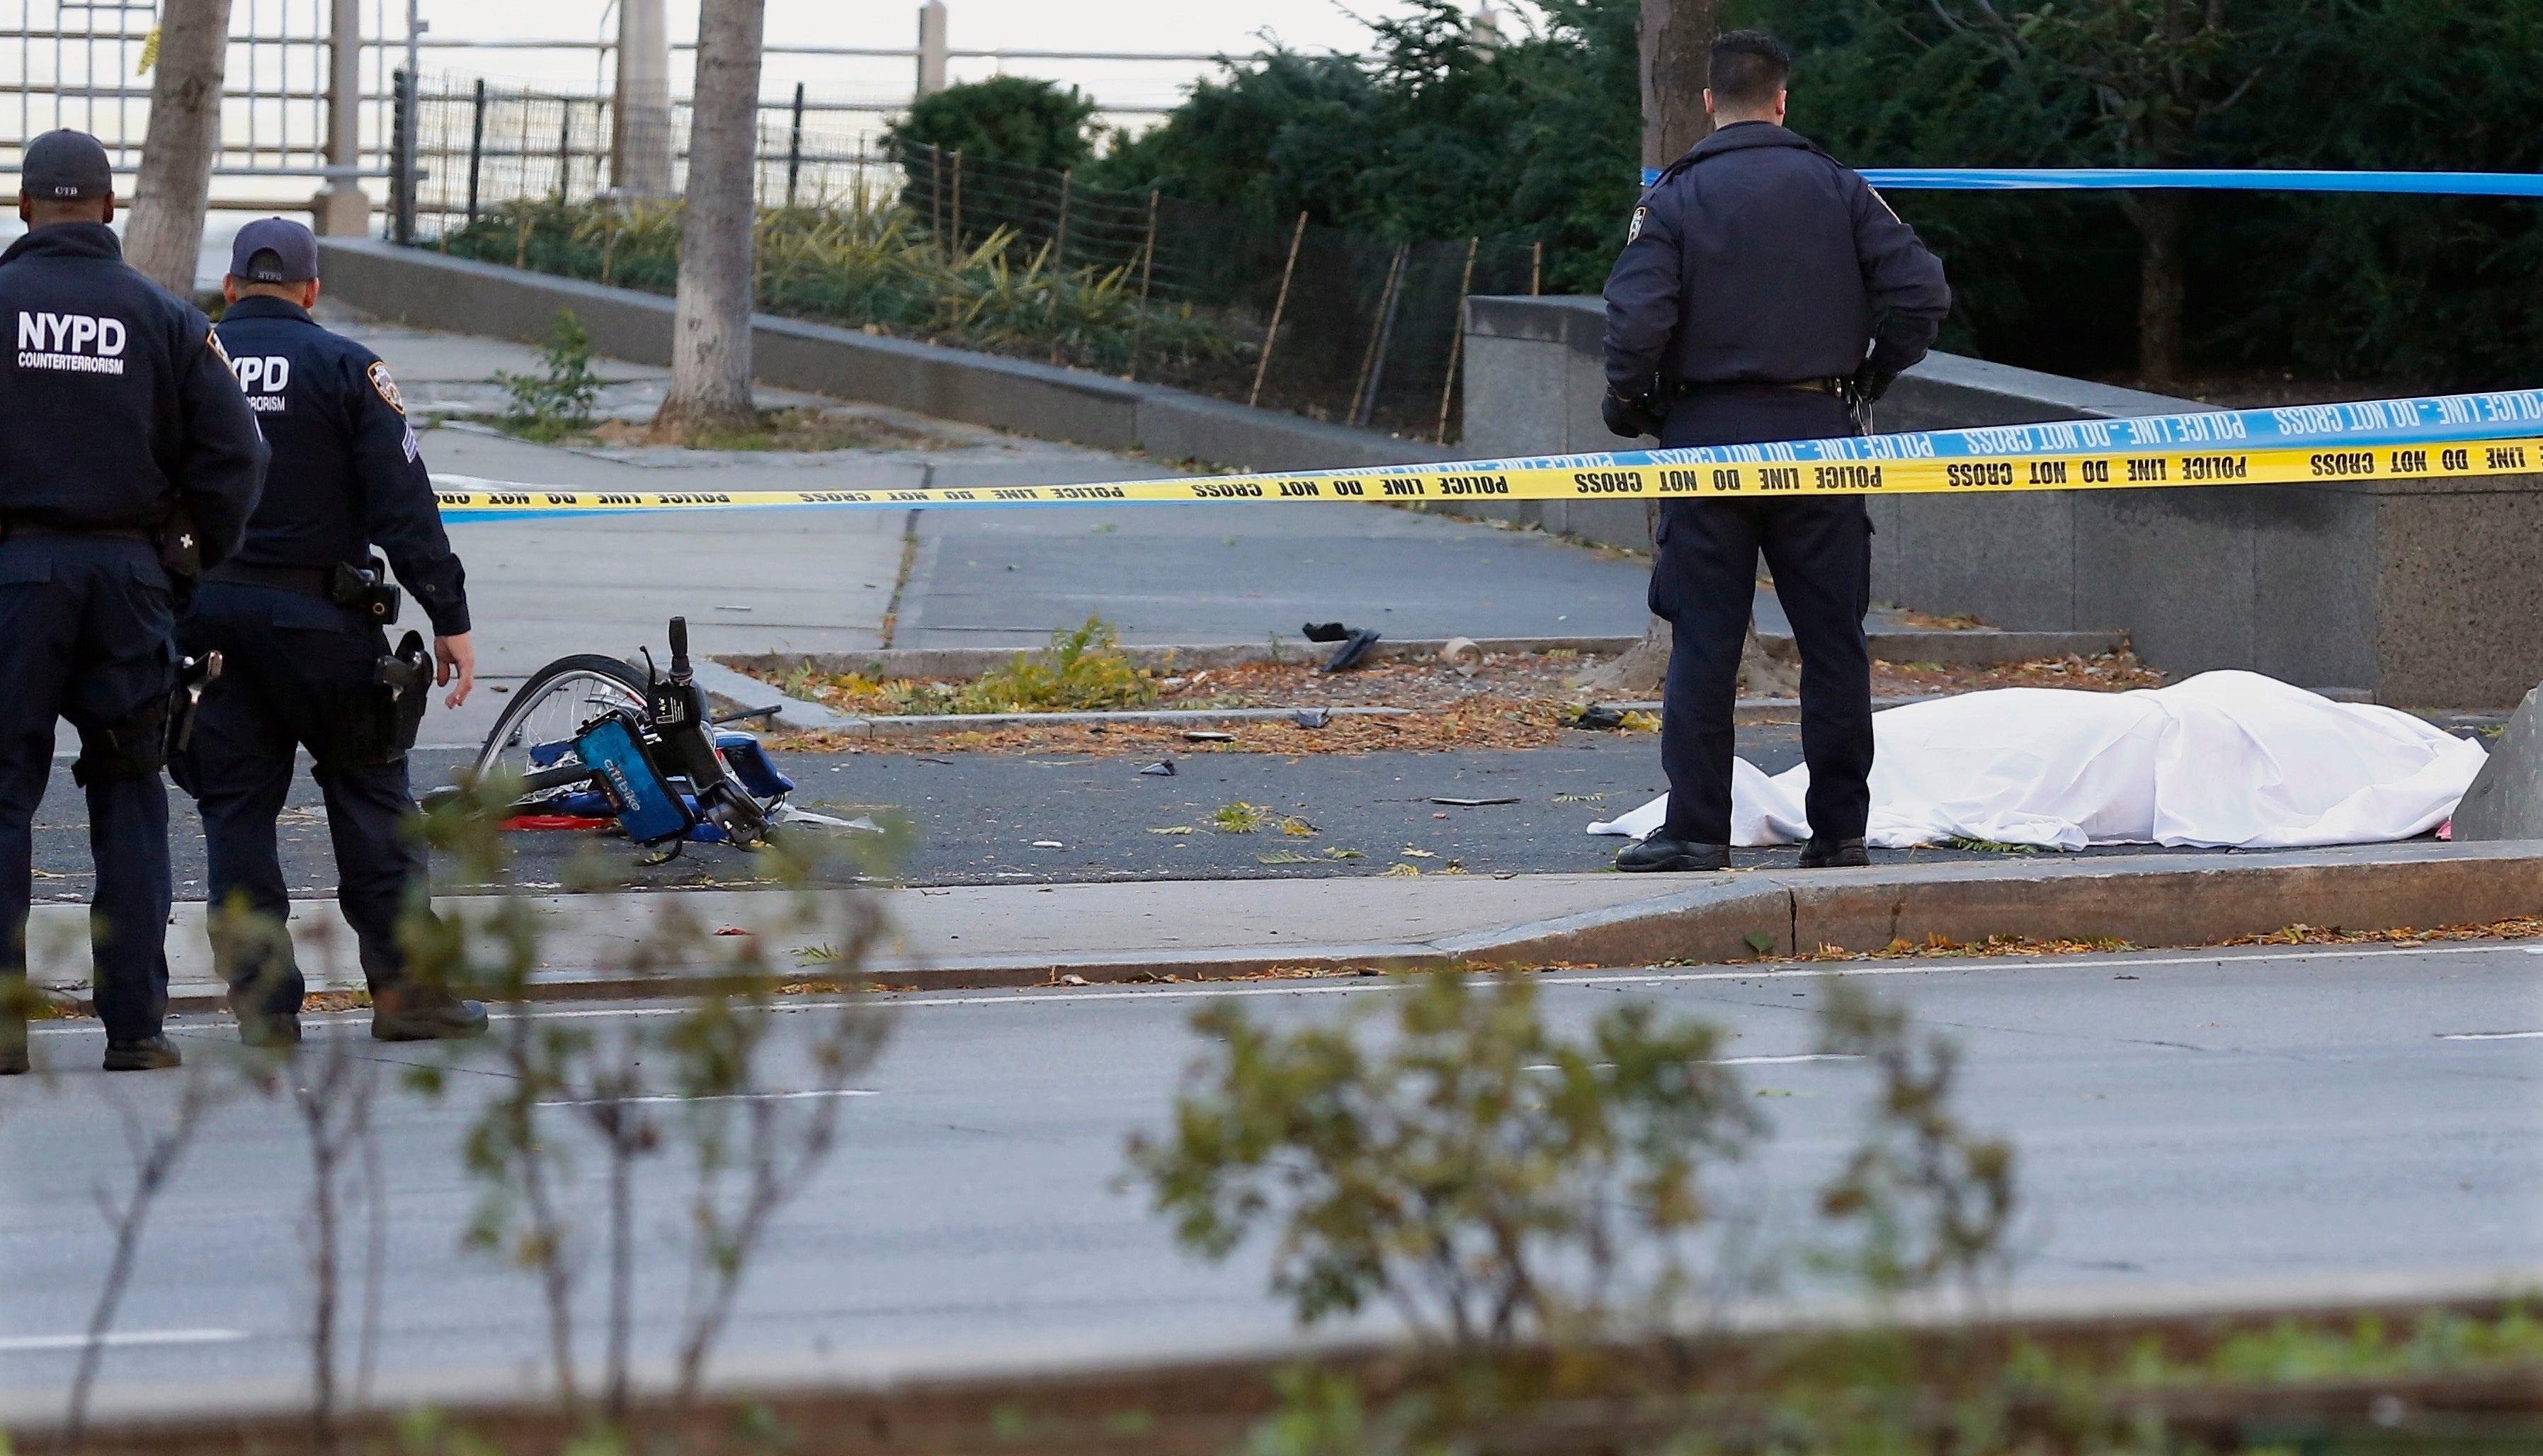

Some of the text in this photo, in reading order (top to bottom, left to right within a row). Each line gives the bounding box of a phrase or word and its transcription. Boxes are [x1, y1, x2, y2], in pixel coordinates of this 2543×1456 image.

[18, 311, 127, 356] NYPD
[18, 351, 124, 375] COUNTERTERRORISM
[2272, 405, 2344, 436] CROSS
[2345, 402, 2389, 431] NOT
[2389, 400, 2420, 428] DO
[2430, 396, 2481, 425] LINE
[2479, 392, 2543, 422] OLICE
[1962, 427, 2033, 455] CROSS
[2037, 424, 2079, 451] NOT
[2078, 422, 2112, 448] DO
[2124, 418, 2173, 445] LINE
[2169, 412, 2247, 443] POLICE
[1808, 437, 1859, 460] LINE
[1857, 433, 1935, 460] POLICE
[2442, 449, 2469, 470] DO
[2486, 446, 2526, 469] LINE
[1947, 456, 2247, 487] POLICE LINE DO NOT CROSS
[2311, 453, 2374, 476] CROSS
[2391, 450, 2428, 473] NOT
[1191, 475, 1509, 497] POLICE LINE DO NOT CROSS
[1574, 465, 1882, 494] POLICE LINE DO NOT CROSS
[544, 492, 578, 504] DO
[594, 492, 642, 504] LINE
[655, 492, 730, 504] POLICE
[798, 486, 1125, 502] POLICE LINE DO NOT CROSS
